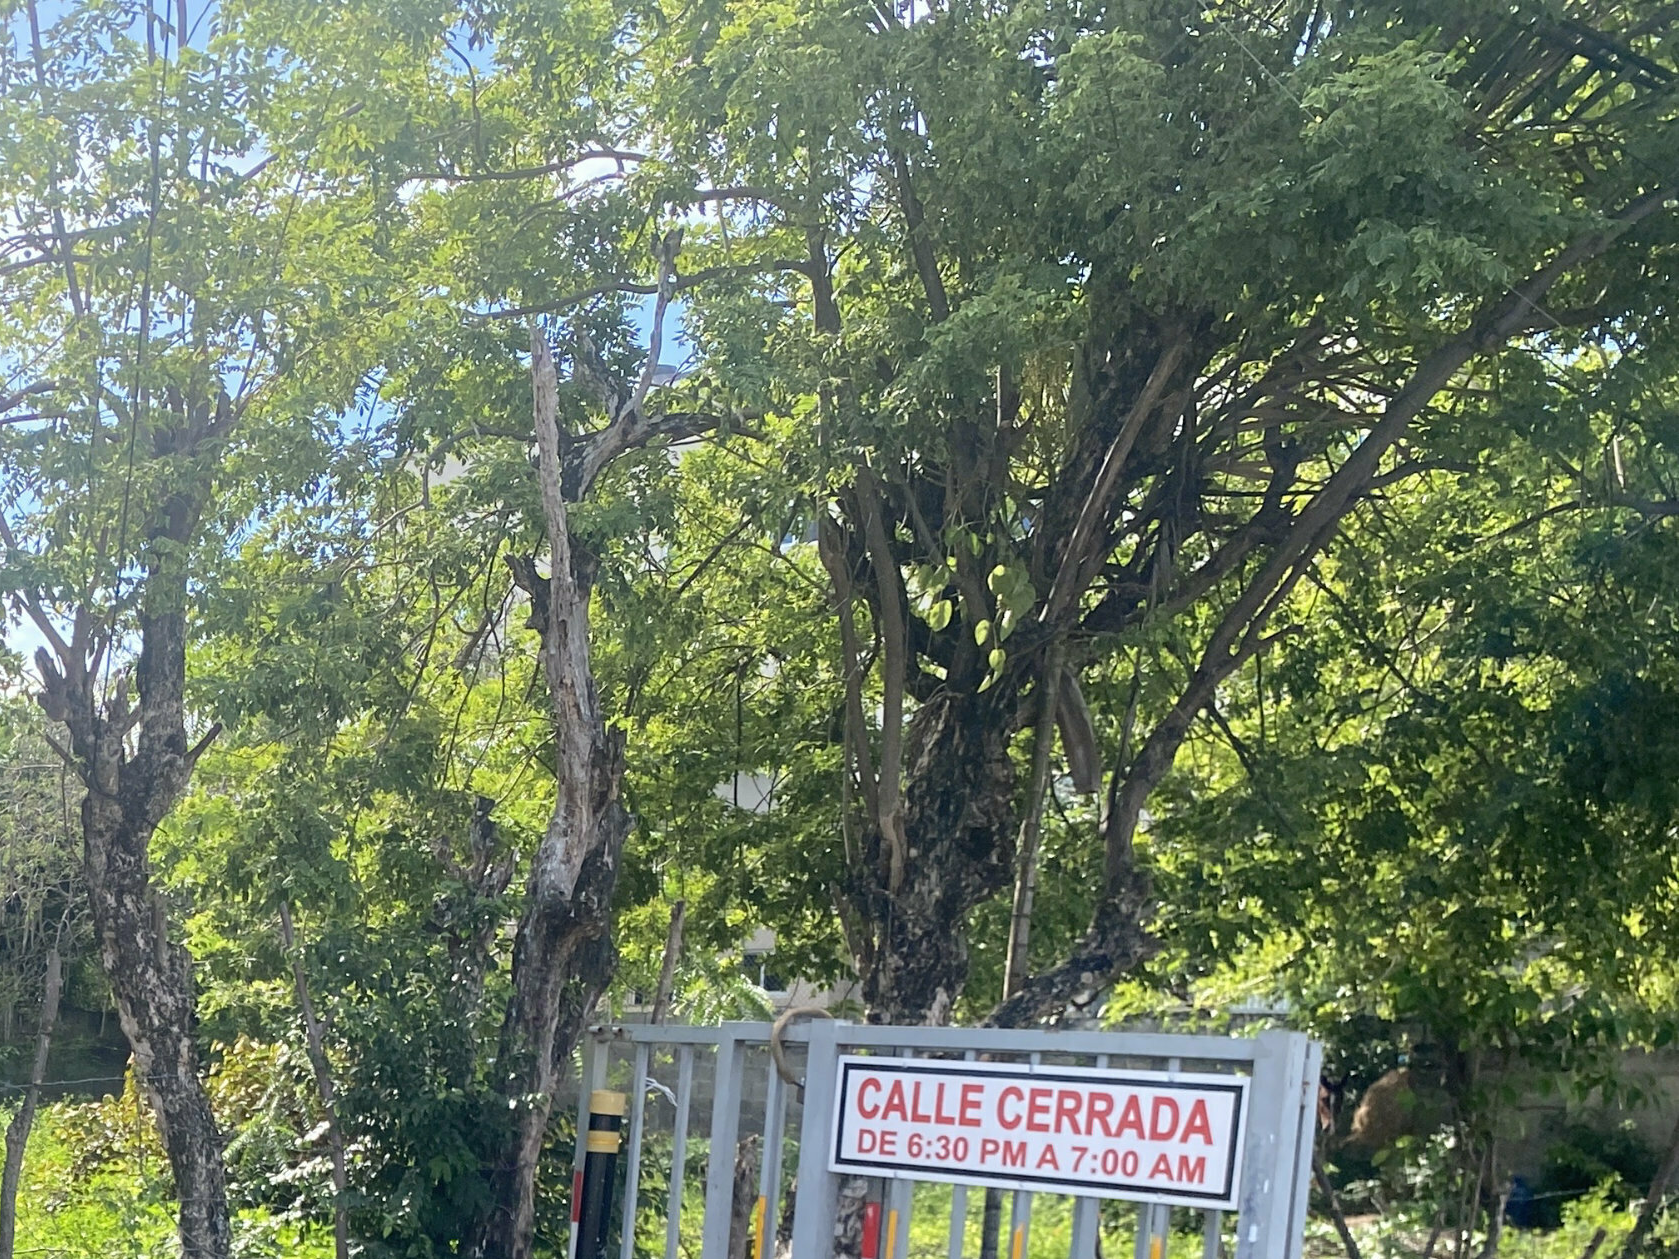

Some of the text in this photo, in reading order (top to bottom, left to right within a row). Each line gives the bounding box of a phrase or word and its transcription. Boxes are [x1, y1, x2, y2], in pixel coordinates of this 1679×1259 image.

[857, 1077, 1214, 1146] CALLE CERRADA
[857, 1129, 1207, 1185] DE 6:30 PM A 7:00 AM
